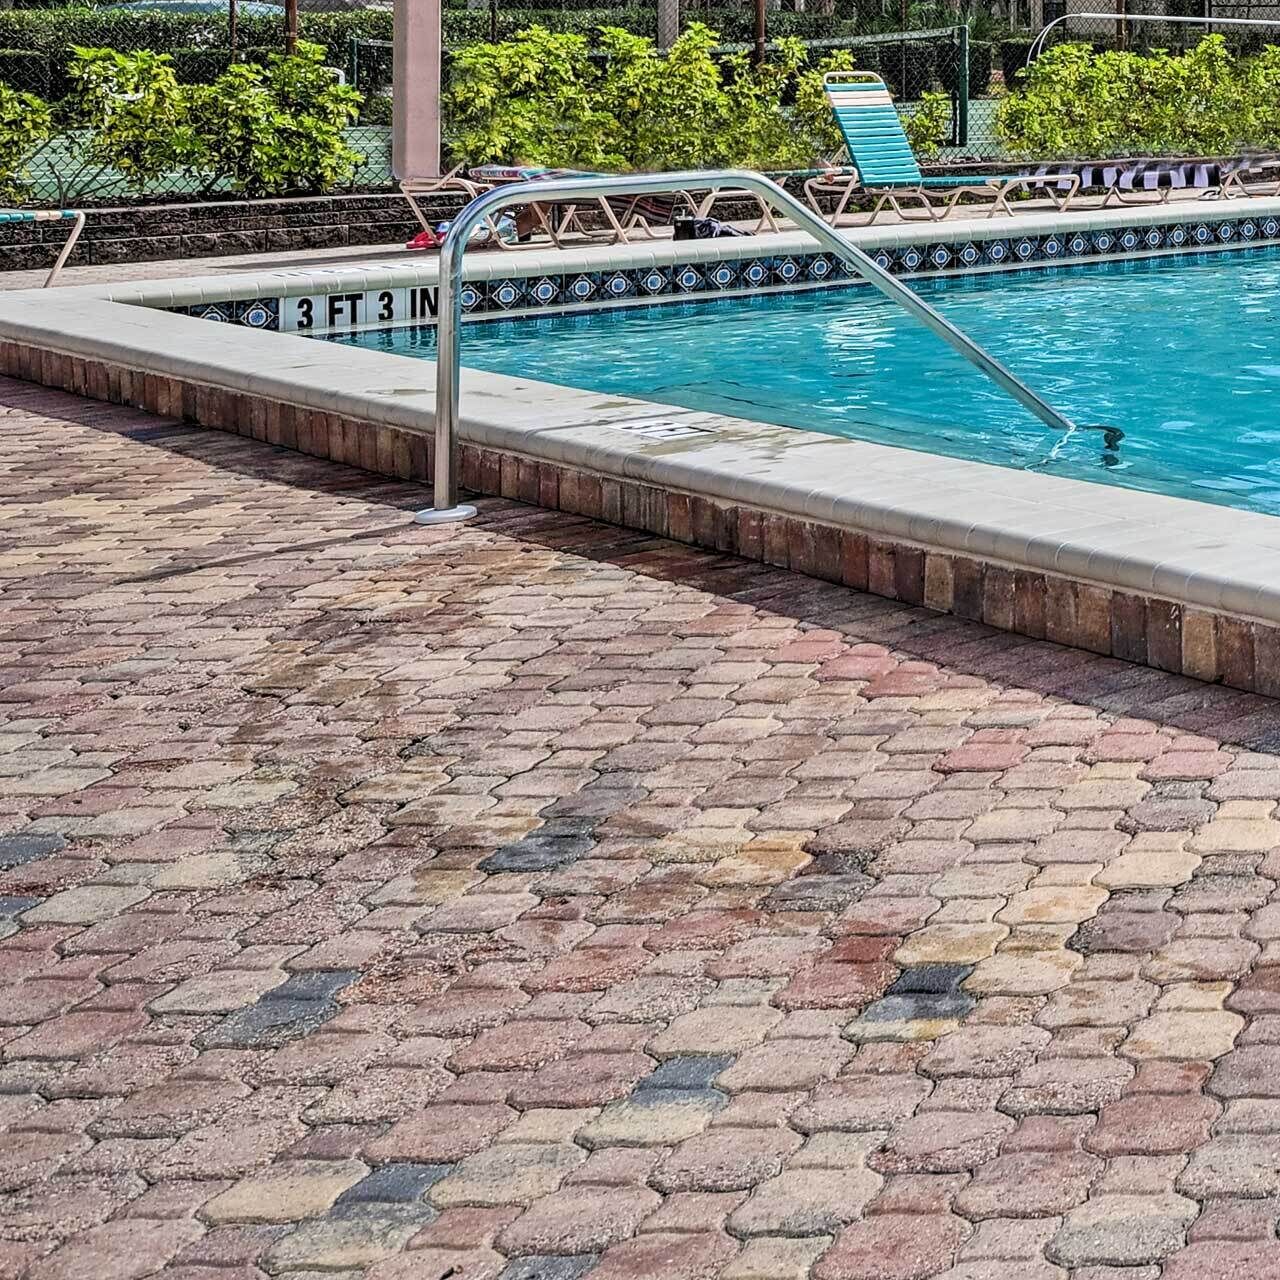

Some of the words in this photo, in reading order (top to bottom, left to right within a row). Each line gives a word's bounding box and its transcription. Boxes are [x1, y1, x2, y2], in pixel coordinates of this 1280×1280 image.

[296, 298, 314, 328] 3
[328, 293, 364, 326] FT
[378, 291, 394, 321] 3
[410, 287, 439, 318] IN
